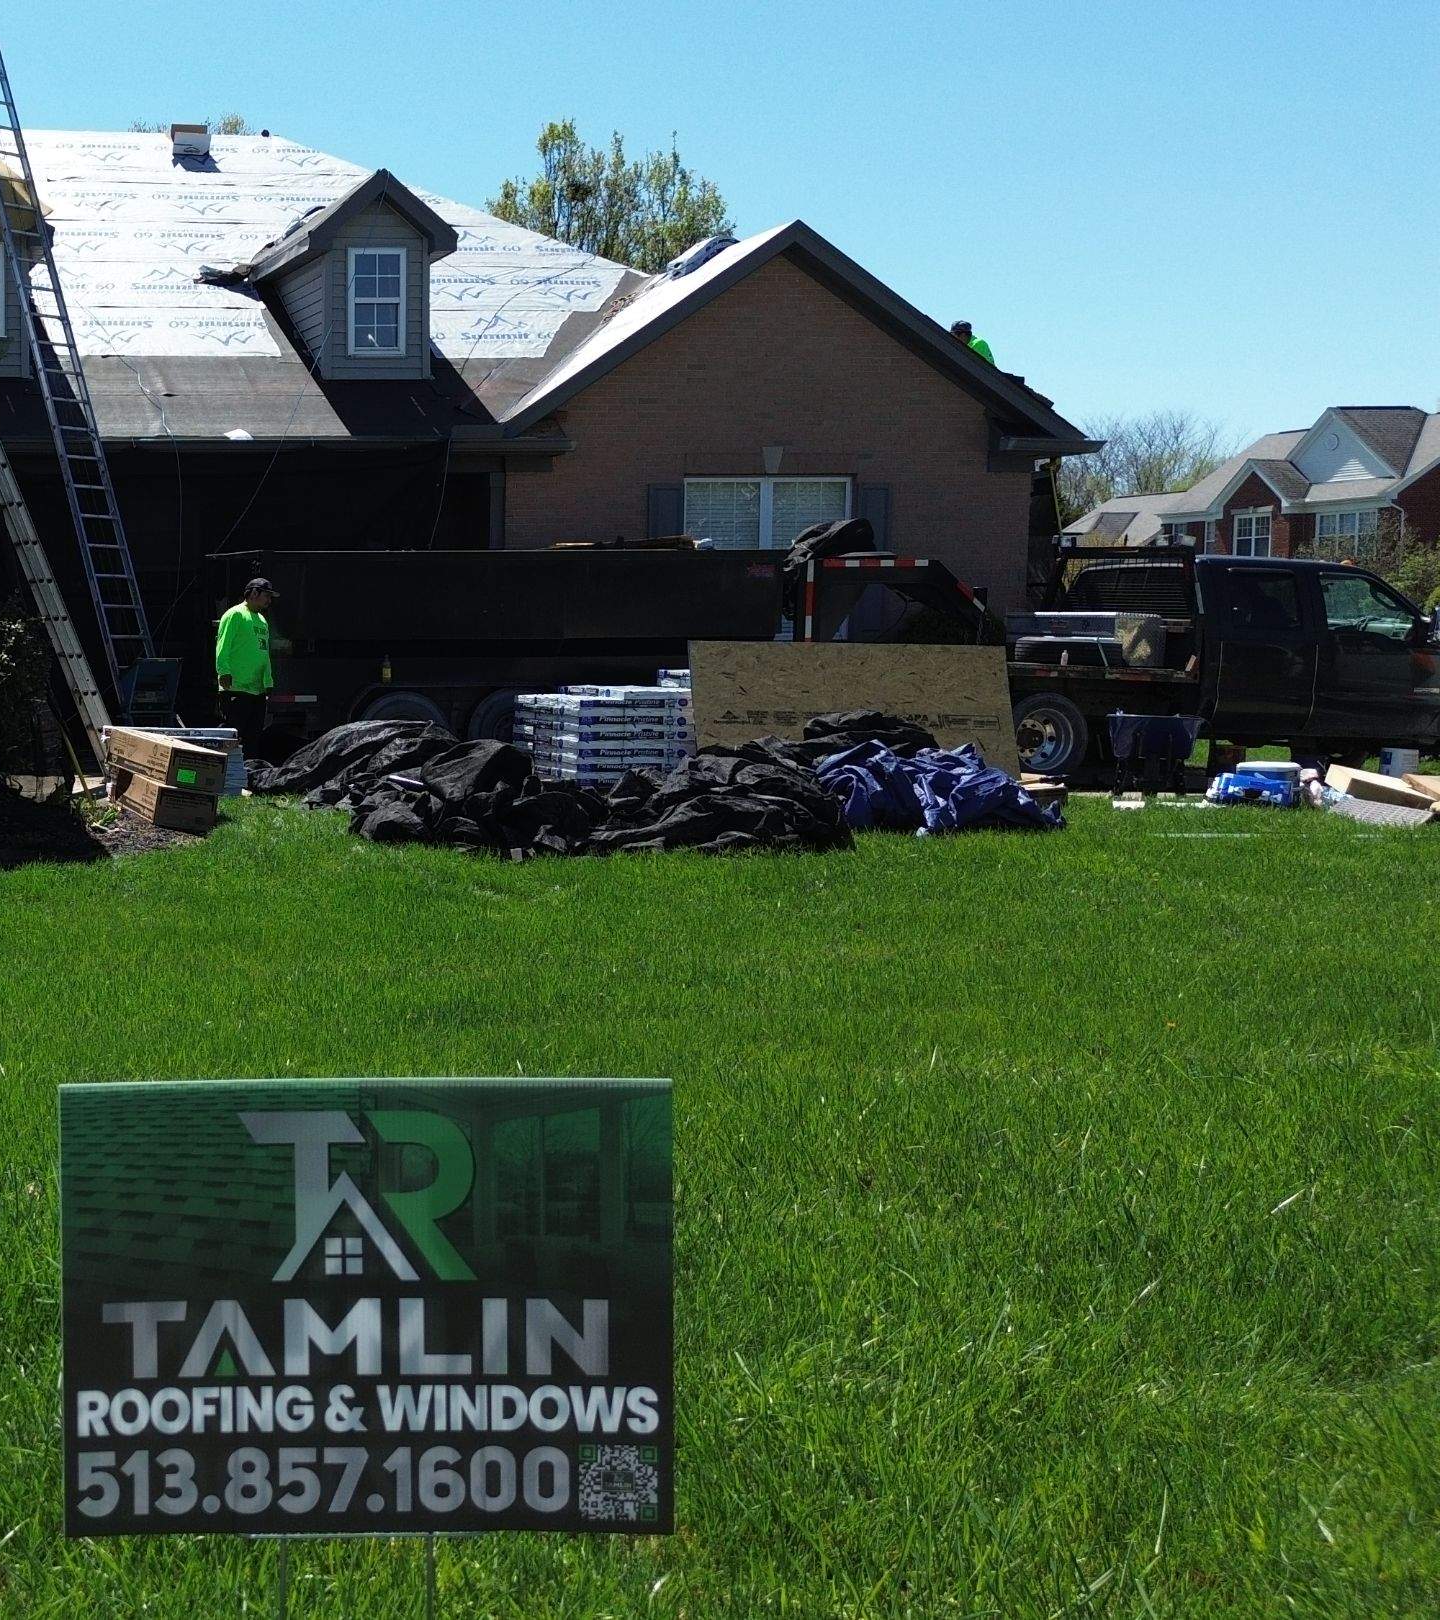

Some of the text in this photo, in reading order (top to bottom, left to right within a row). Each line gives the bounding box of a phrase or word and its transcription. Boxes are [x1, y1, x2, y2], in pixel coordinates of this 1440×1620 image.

[460, 332, 531, 340] Summit
[599, 715, 632, 723] Pinnacle
[599, 730, 659, 738] Pinnacle Pristine
[599, 748, 632, 757] Pinnacle
[102, 1297, 610, 1378] TAMLIN
[77, 1383, 659, 1438] ROOFING & WINDOWS
[77, 1445, 570, 1517] 513.857.1600
